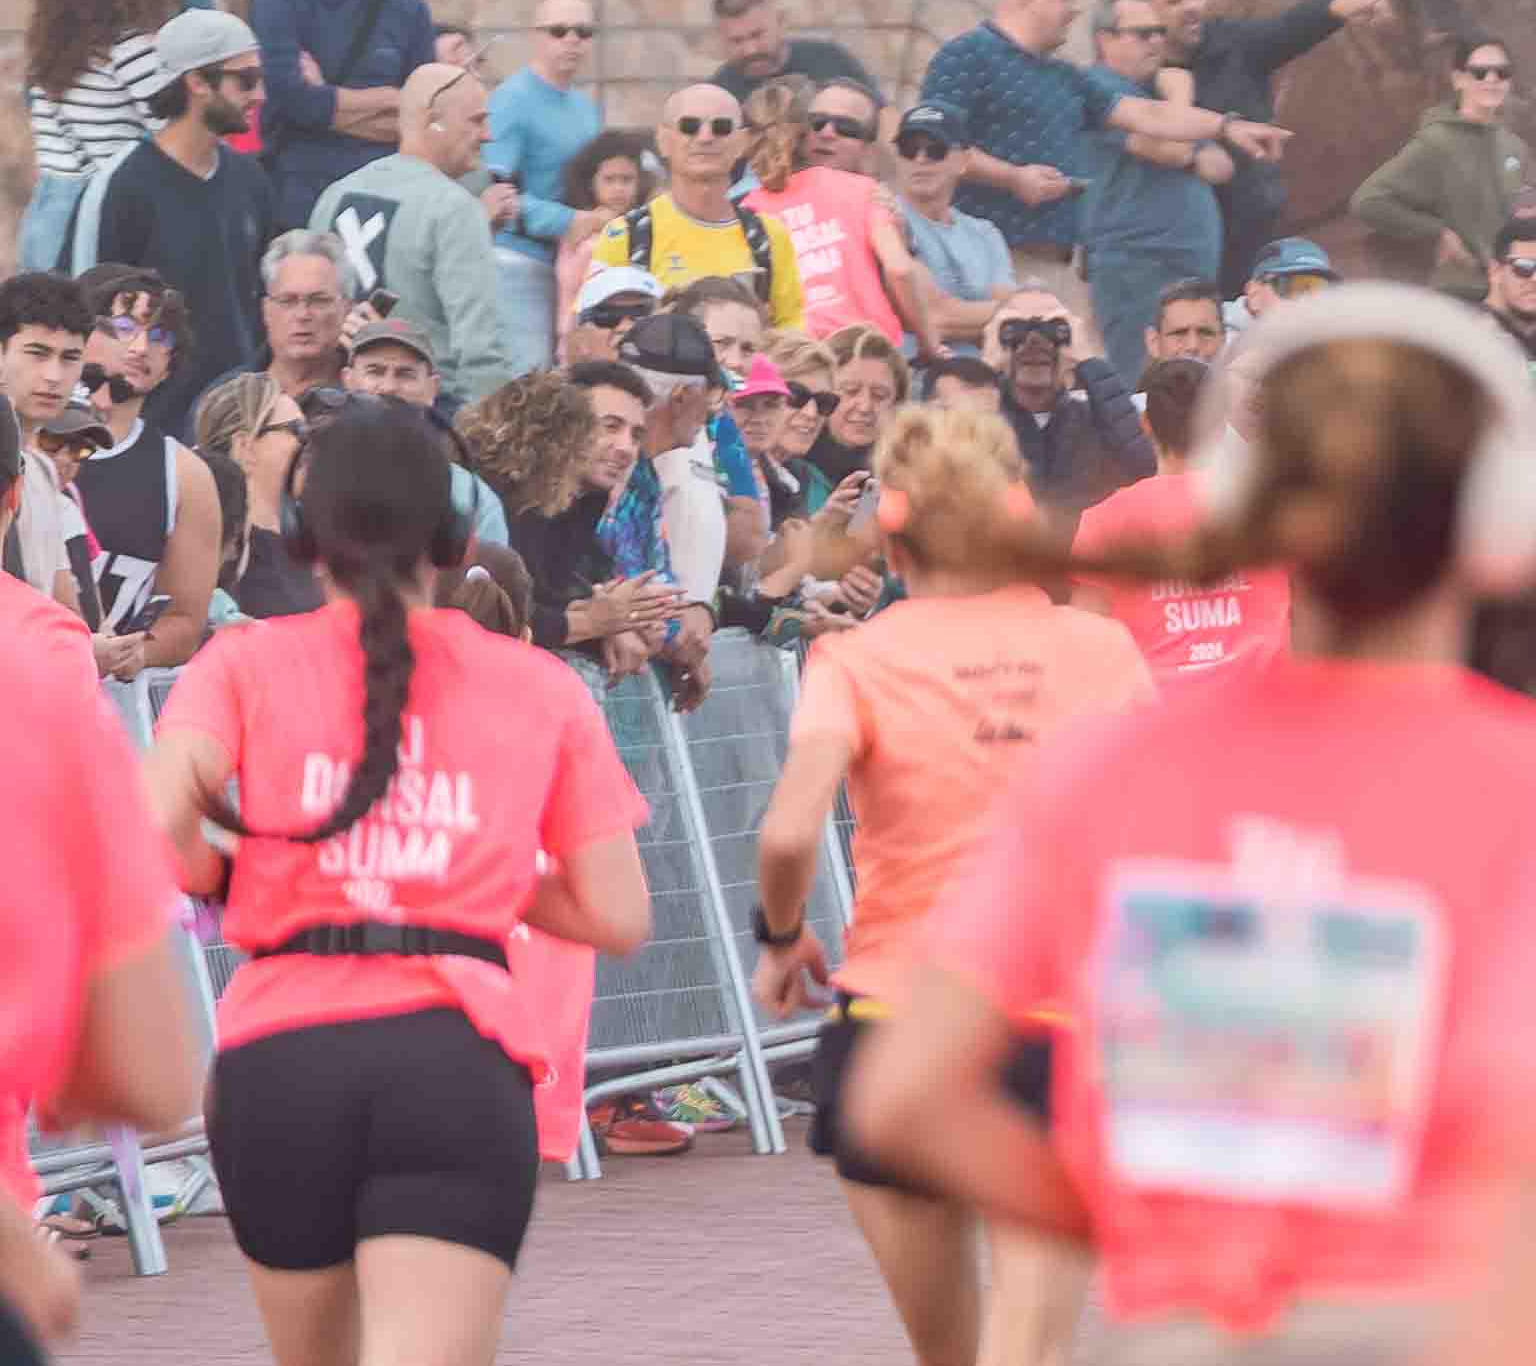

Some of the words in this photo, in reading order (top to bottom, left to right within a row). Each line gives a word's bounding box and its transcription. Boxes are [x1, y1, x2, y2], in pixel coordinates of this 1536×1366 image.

[1164, 597, 1243, 634] SUMA
[301, 751, 481, 833] DSAL
[318, 821, 451, 885] SUMA
